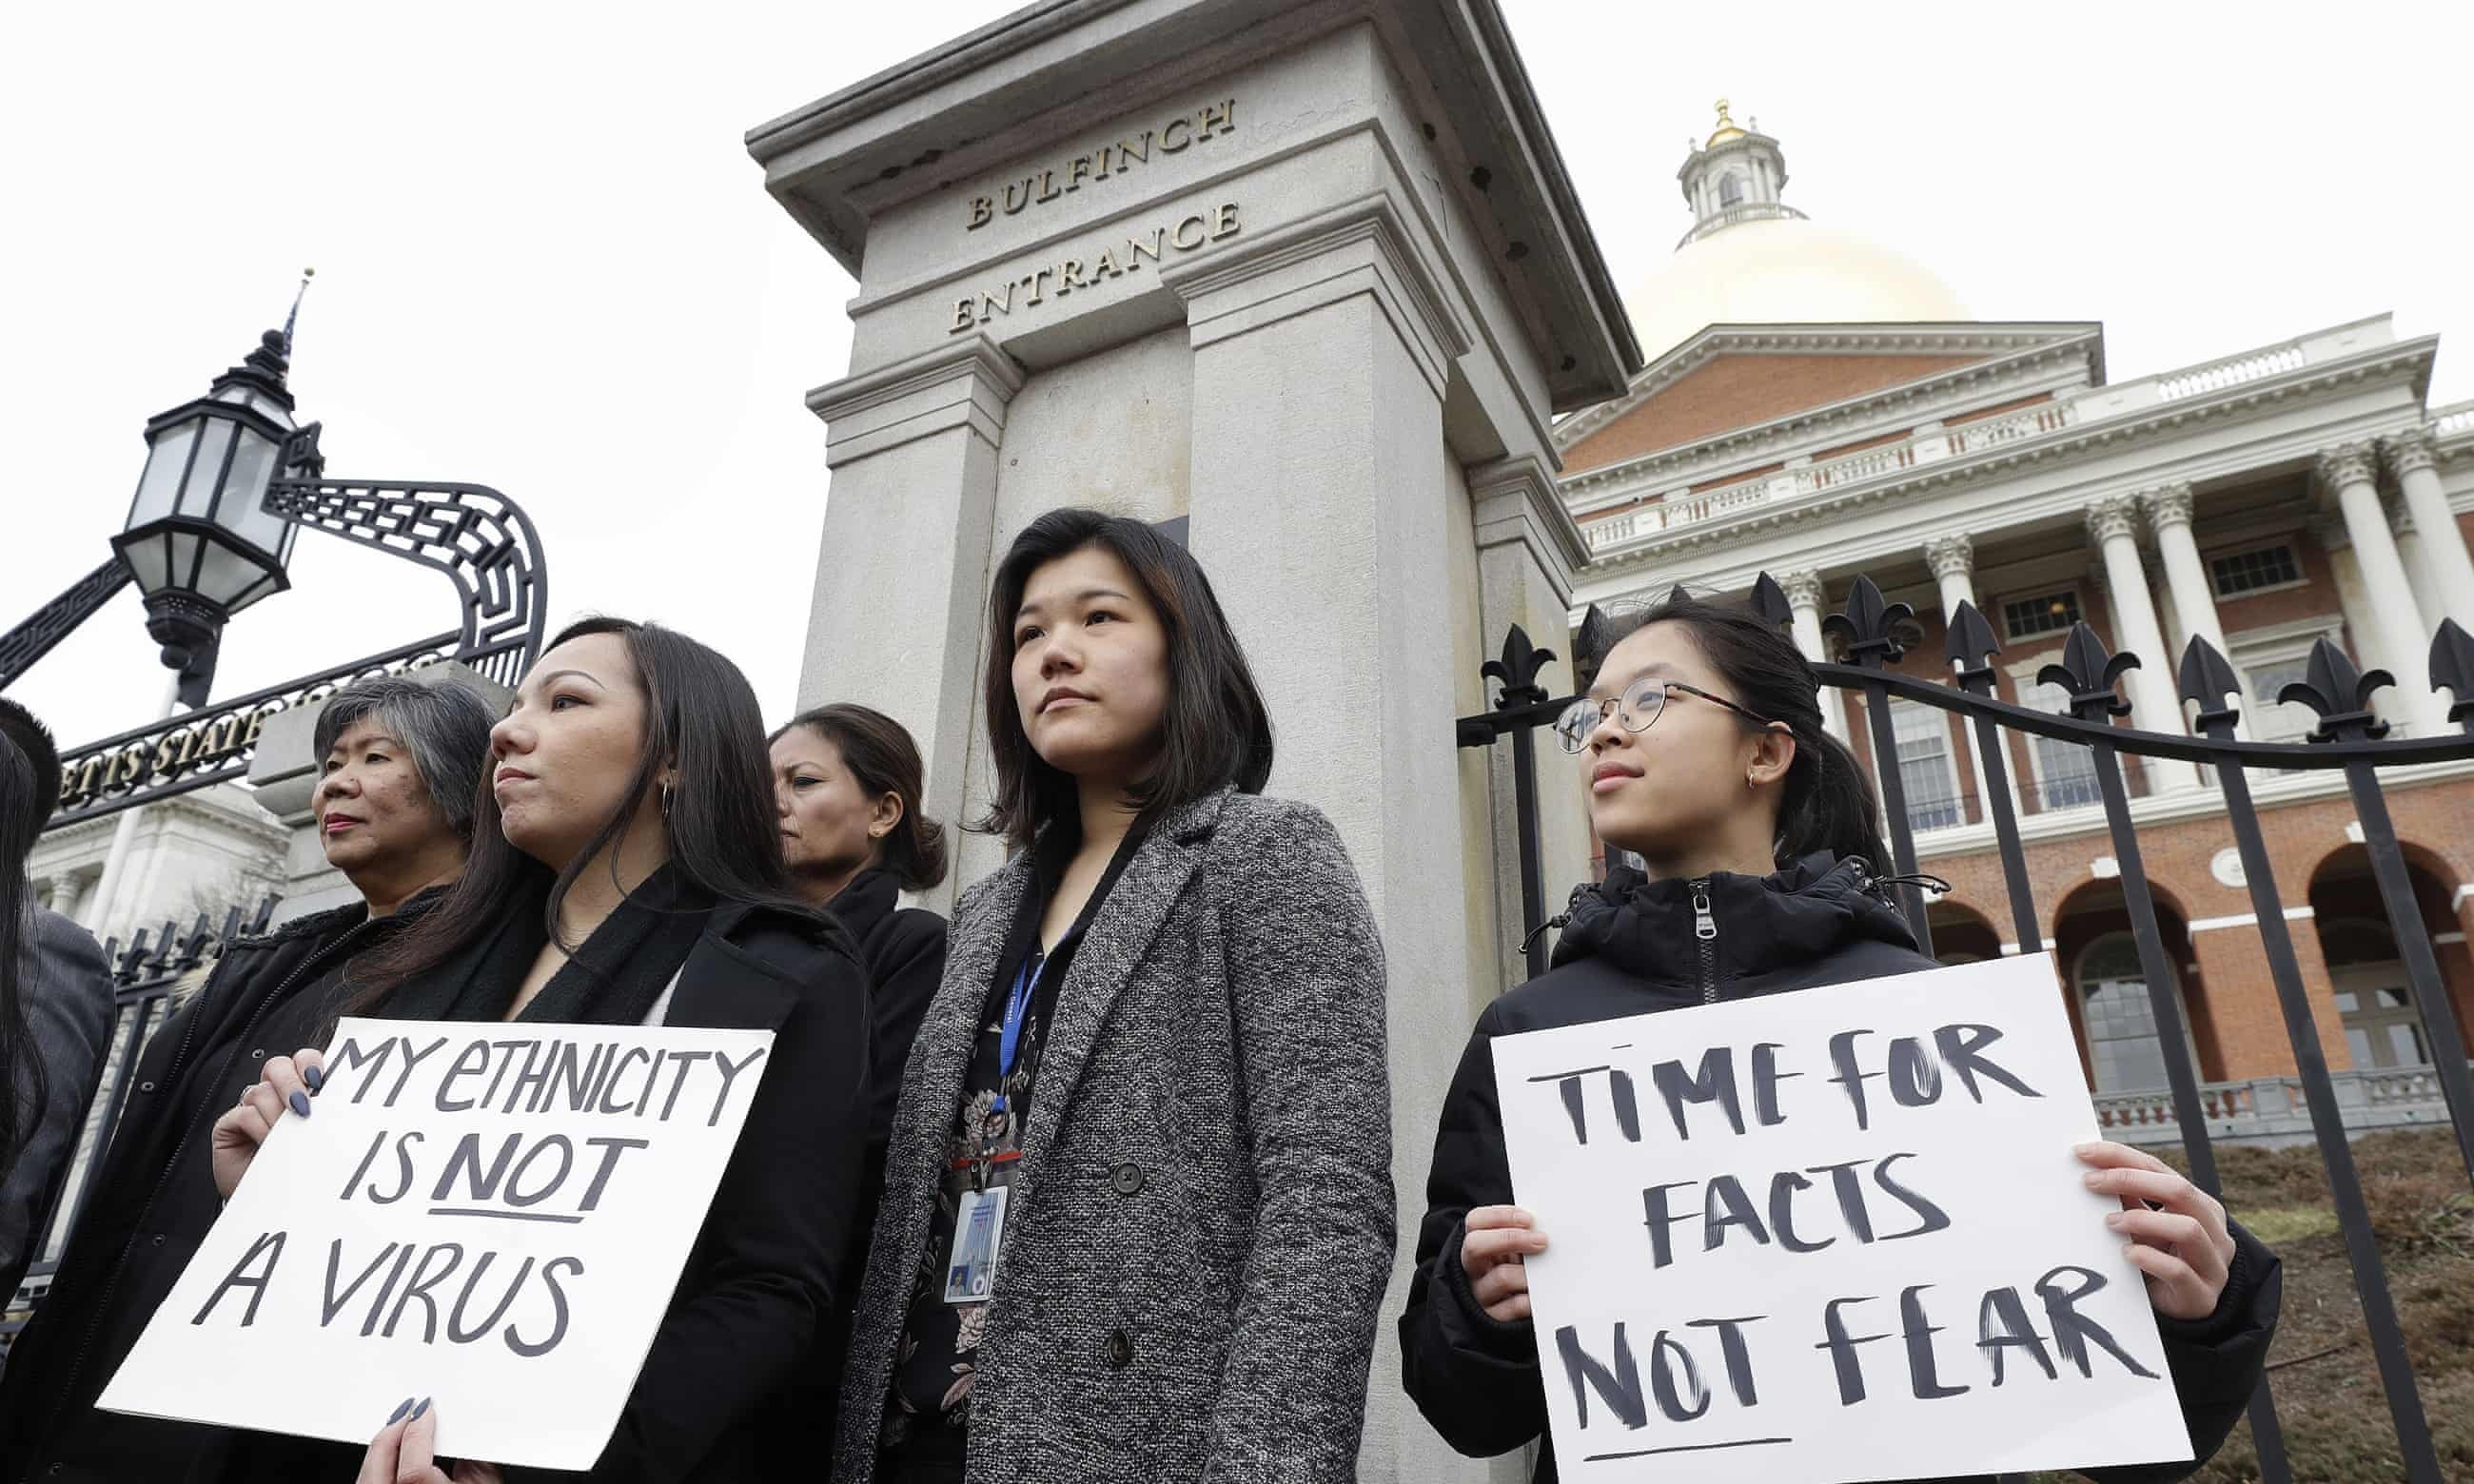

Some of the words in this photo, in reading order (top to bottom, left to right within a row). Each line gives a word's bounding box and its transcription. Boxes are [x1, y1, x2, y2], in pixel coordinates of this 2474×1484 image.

[967, 98, 1235, 230] BULFINCH
[950, 202, 1241, 334] ENTRANCE
[151, 708, 276, 771] STATE
[311, 1037, 449, 1107] MY
[1827, 1024, 2045, 1130] FOR
[340, 1131, 425, 1204] IS
[431, 1133, 650, 1212] NOT
[1642, 1152, 1952, 1269] FACTS
[190, 1232, 288, 1328] A
[321, 1239, 585, 1357] VIRUS
[1555, 1316, 1769, 1430] NOT
[1815, 1265, 2161, 1407] FEAR
